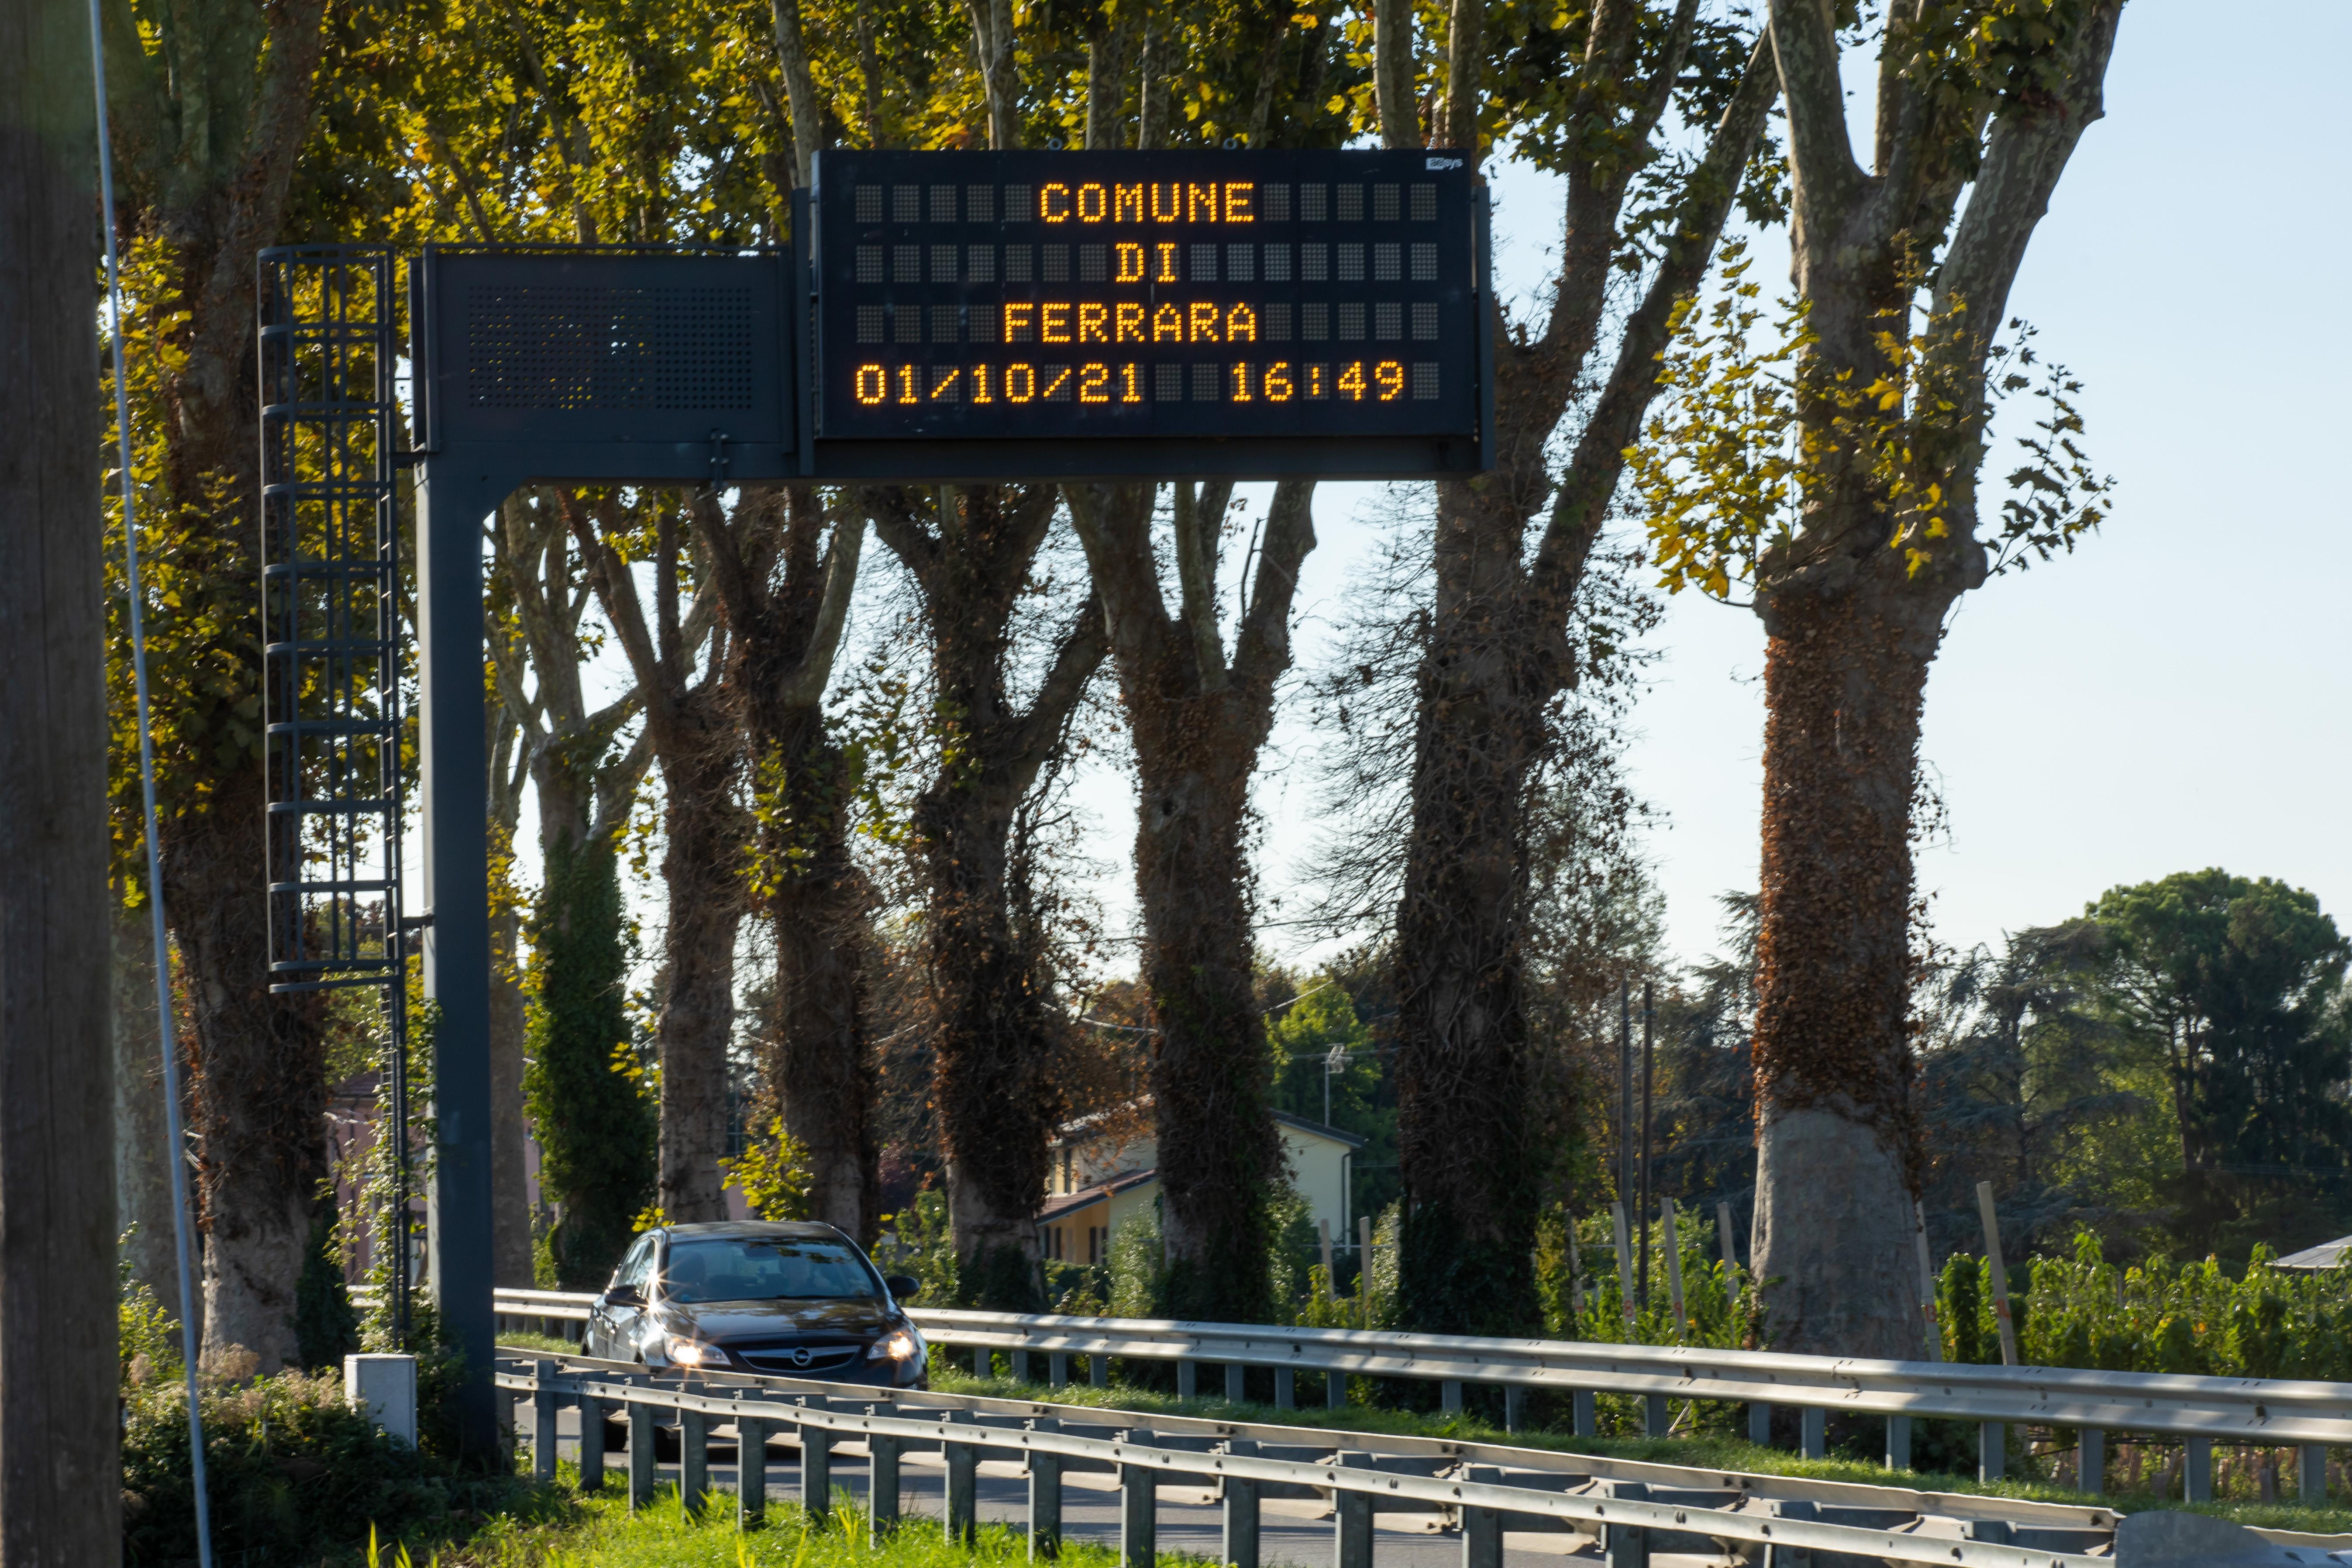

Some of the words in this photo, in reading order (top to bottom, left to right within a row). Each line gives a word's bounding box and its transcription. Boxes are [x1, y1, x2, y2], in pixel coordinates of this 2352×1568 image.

[1041, 183, 1254, 222] COMUNE
[1116, 243, 1175, 282] DI
[1005, 303, 1256, 343] FERRARA
[856, 363, 1140, 404] 01/10/21
[1233, 361, 1403, 401] 16:49
[1623, 1299, 1634, 1317] 8
[1674, 1301, 1684, 1318] 9
